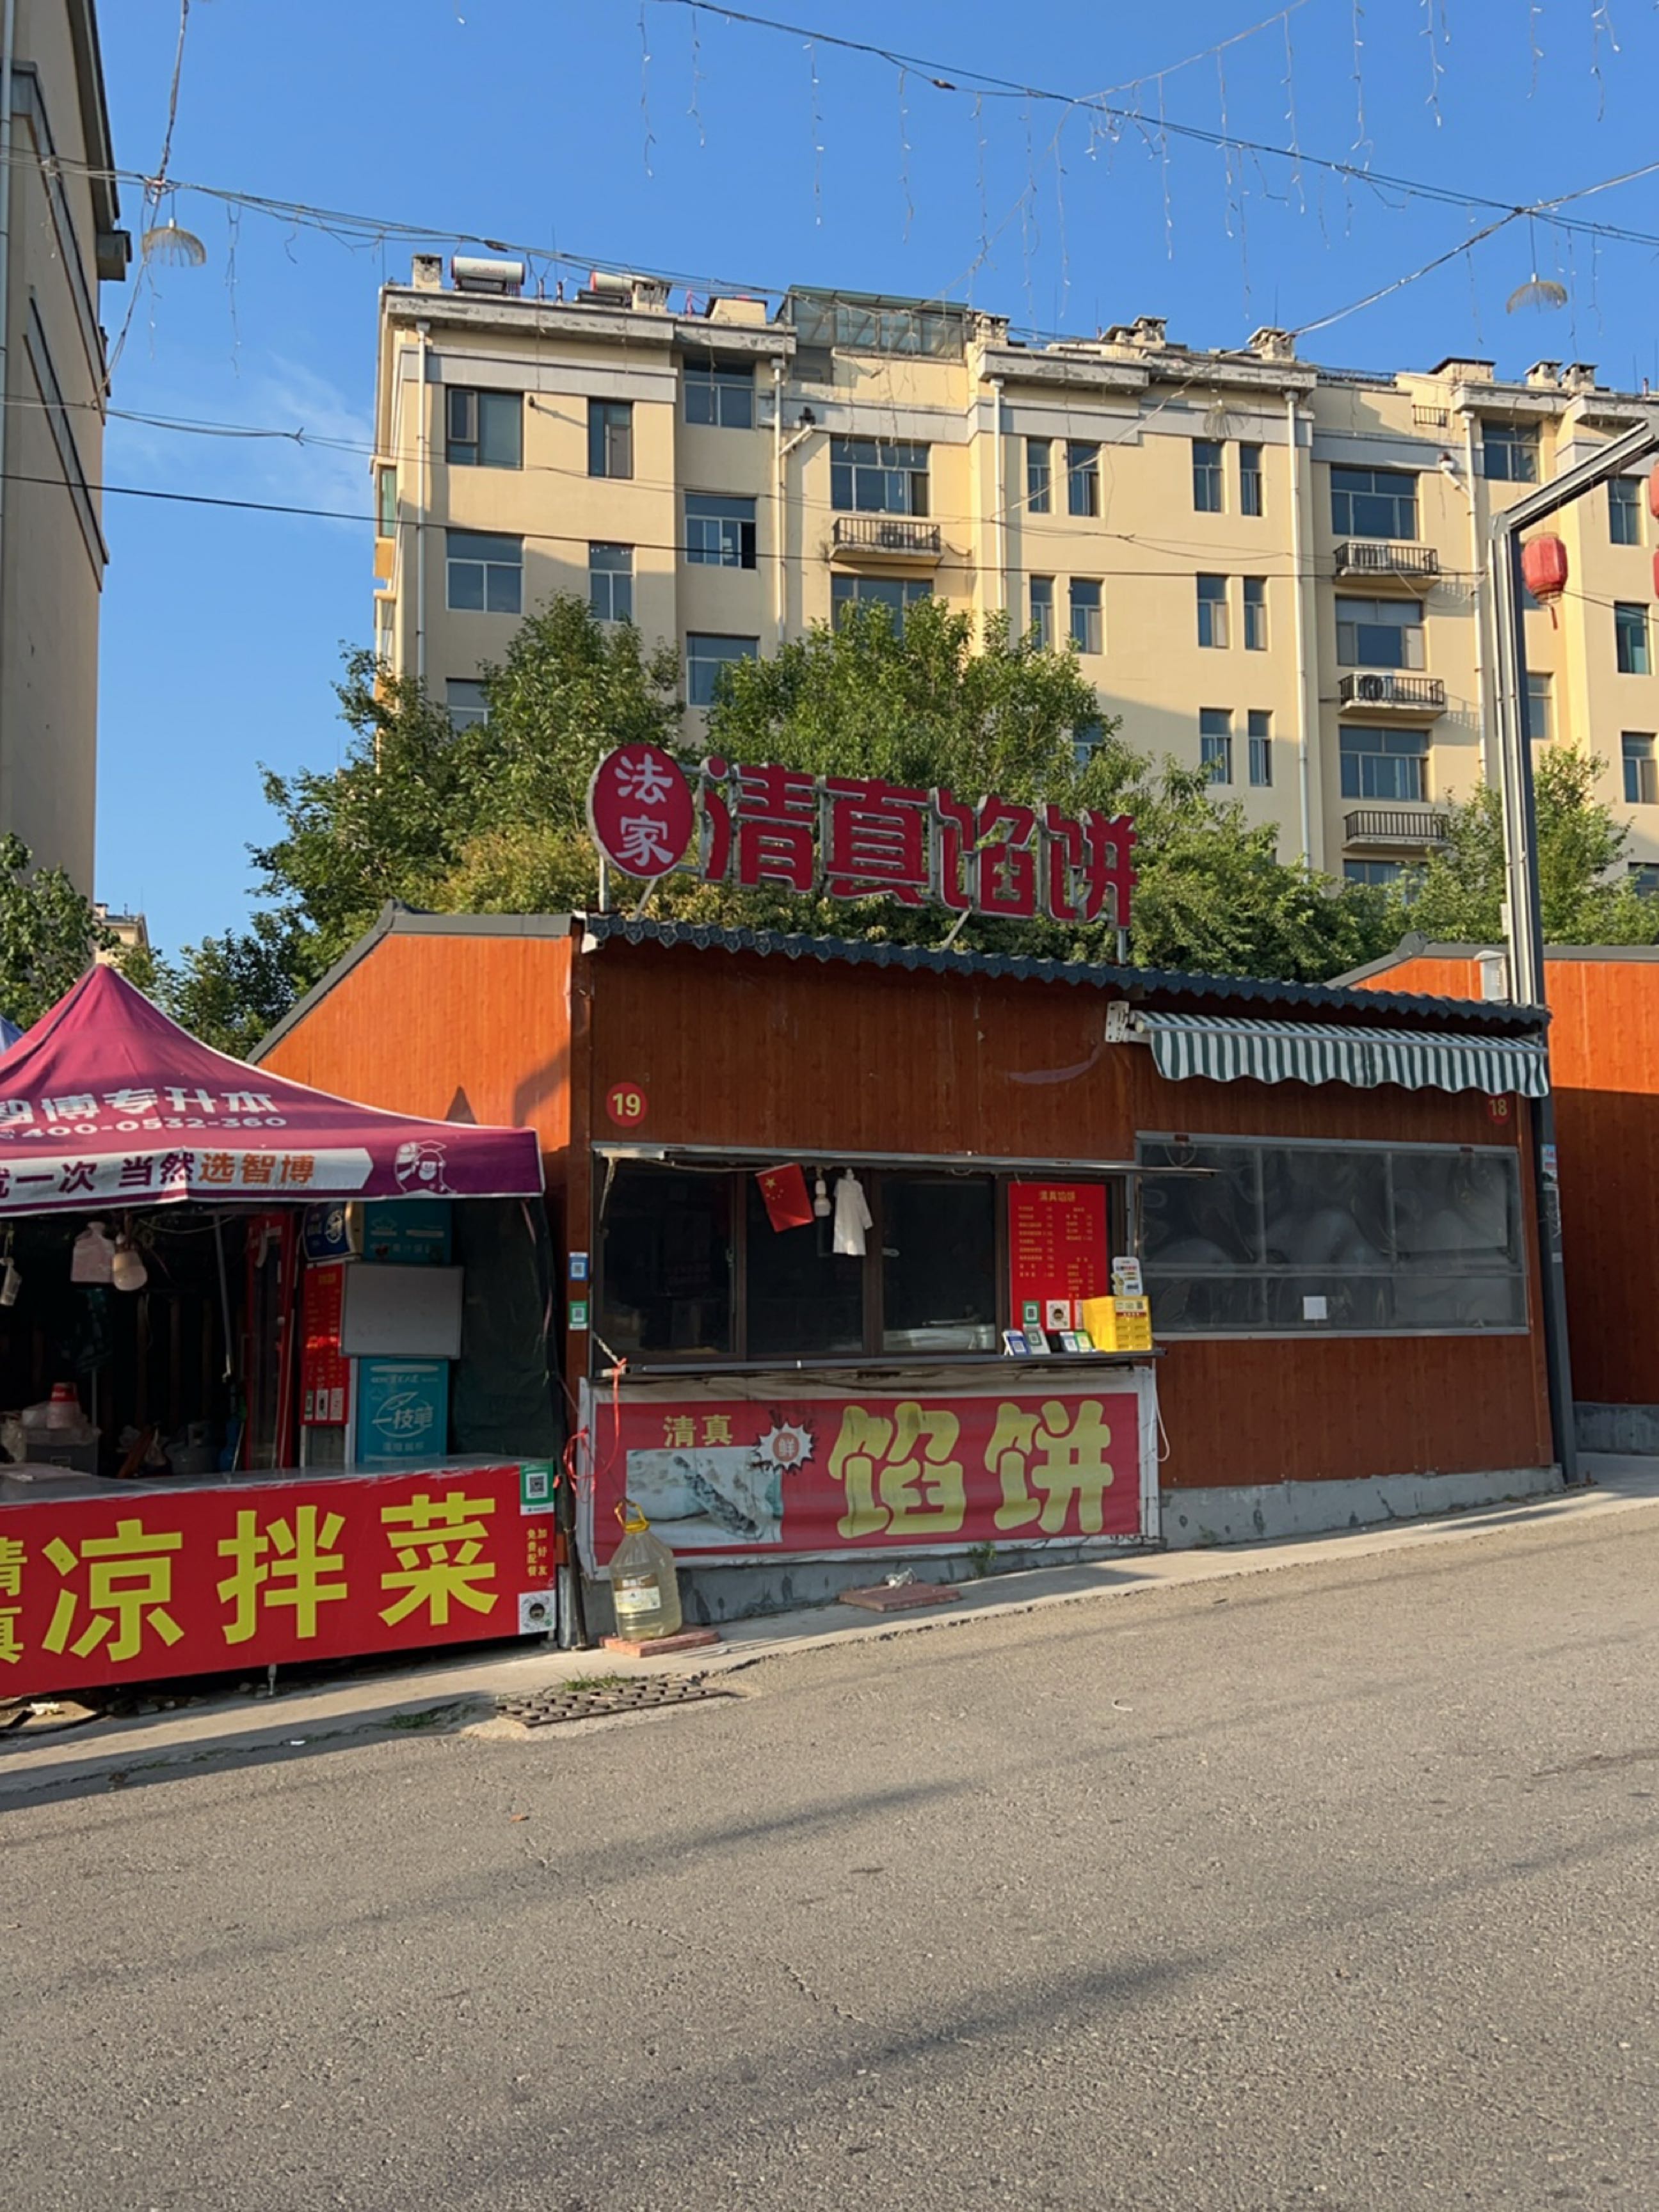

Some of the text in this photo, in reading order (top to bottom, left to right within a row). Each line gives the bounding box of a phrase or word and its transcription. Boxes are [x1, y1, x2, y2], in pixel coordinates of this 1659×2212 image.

[613, 751, 673, 867] 法家
[700, 755, 1139, 928] 清真馅饼
[22, 1117, 287, 1137] 400-0532-360
[613, 1093, 640, 1118] 19
[1489, 1099, 1507, 1116] 18
[0, 1152, 314, 1199] 一次 当然选智博
[663, 1414, 733, 1448] 清真
[828, 1400, 1114, 1539] 馅饼
[42, 1493, 498, 1662] 凉拌菜
